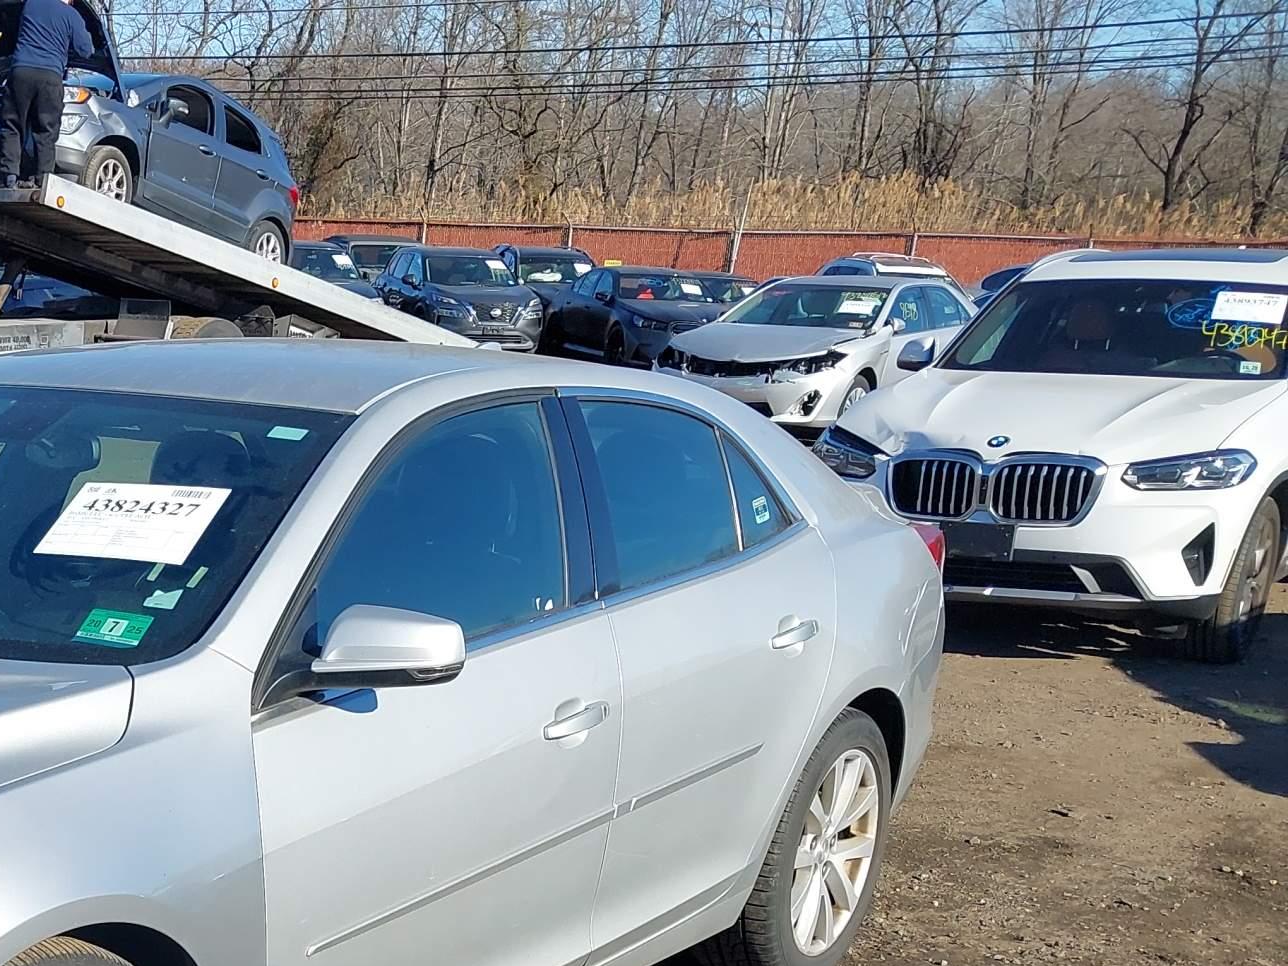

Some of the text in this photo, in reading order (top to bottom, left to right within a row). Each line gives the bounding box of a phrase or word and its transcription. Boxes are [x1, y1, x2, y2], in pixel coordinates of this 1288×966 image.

[83, 498, 201, 518] 43824327
[86, 619, 143, 635] 20 7 25
